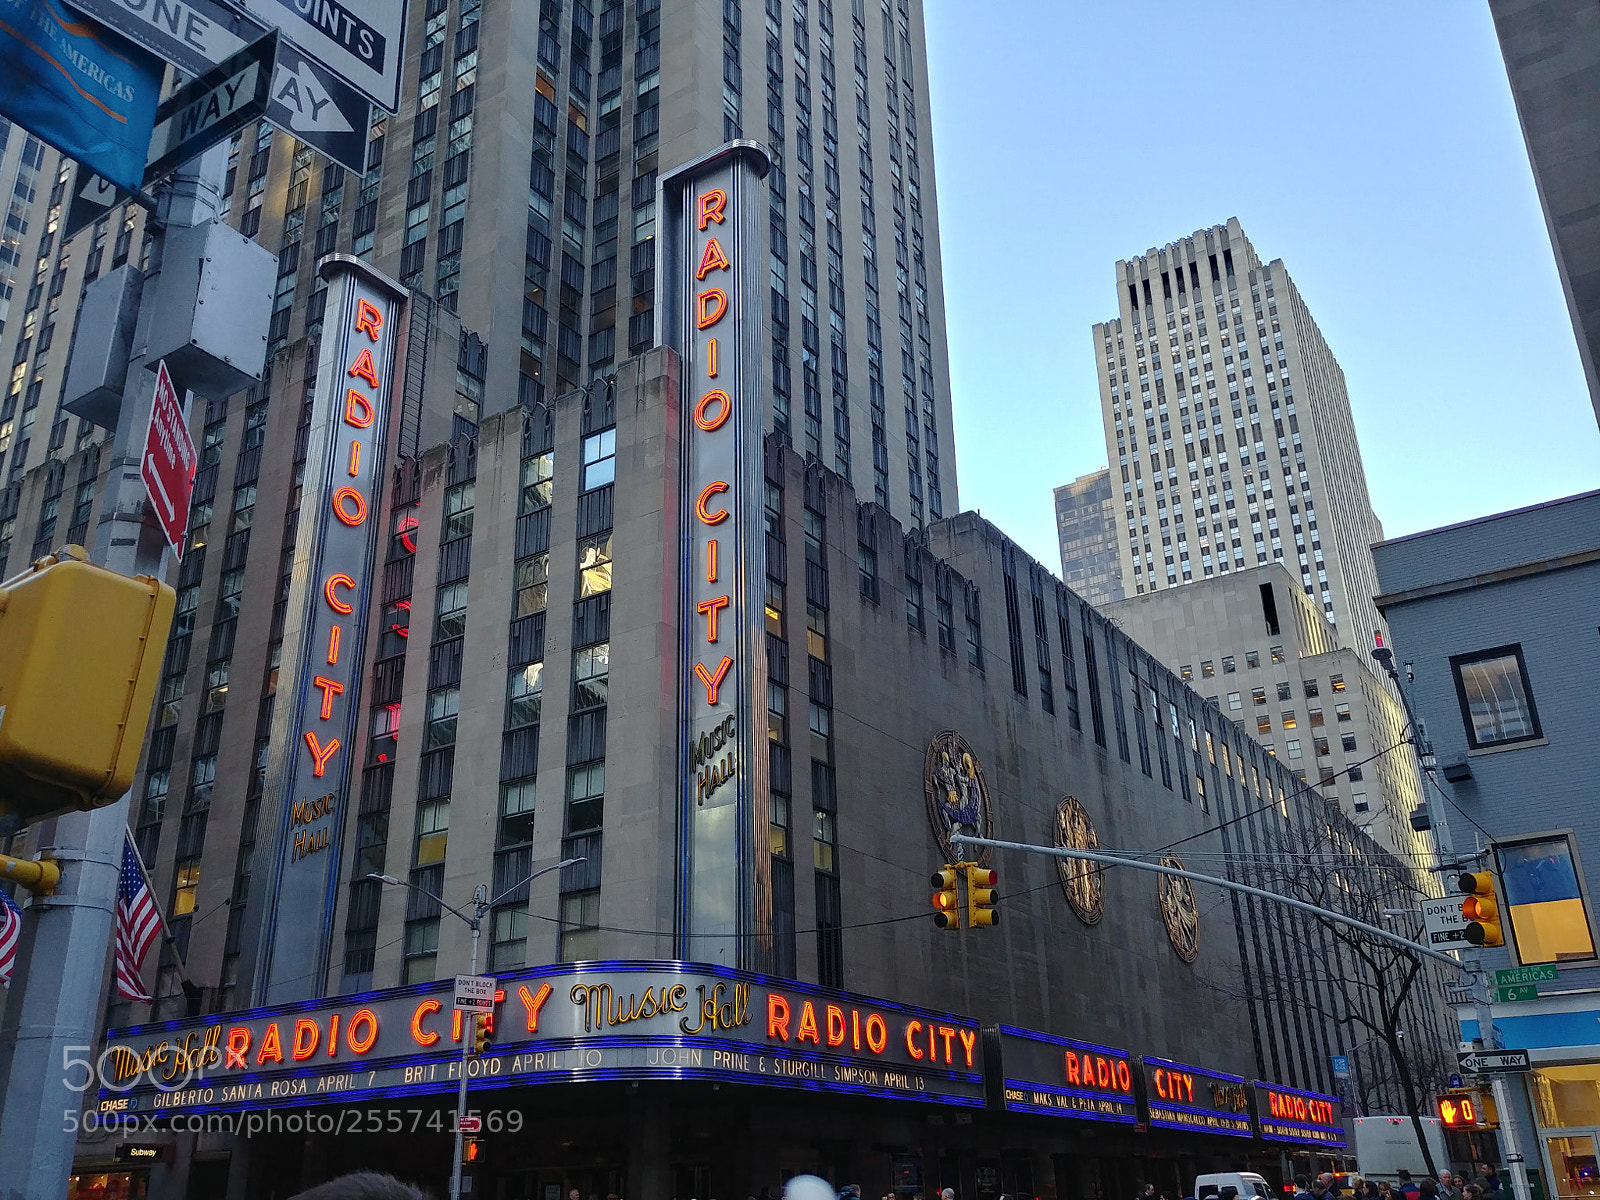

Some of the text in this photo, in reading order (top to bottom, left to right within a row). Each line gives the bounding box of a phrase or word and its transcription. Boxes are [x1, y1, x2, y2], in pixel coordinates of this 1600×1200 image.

[59, 37, 135, 103] AMERICAS
[180, 75, 246, 140] WAY
[276, 75, 330, 122] AY
[694, 188, 731, 432] RADIO
[159, 379, 190, 471] NO STANDING
[333, 298, 383, 526] RADIO
[694, 480, 733, 706] CITY
[304, 573, 356, 777] CITY
[1427, 904, 1454, 915] DON'T
[1440, 915, 1459, 925] THE
[1433, 932, 1450, 942] FINE
[1500, 970, 1554, 985] AMERICAS
[1508, 988, 1517, 1000] 6
[110, 1040, 169, 1082] Music
[162, 1024, 222, 1081] Hall
[225, 1008, 379, 1070] RADIO
[570, 982, 688, 1033] Music
[680, 981, 753, 1034] Hall
[768, 992, 887, 1054] RADIO
[905, 1019, 976, 1067] CITY
[153, 1048, 925, 1108] GILBERTO SANTA ROSA APRIL 7 BRIT FLOYD APRIL 10 JOHN PRINE & STURGILL SIMPSON APRIL 13
[1065, 1050, 1131, 1092] RADIO
[1465, 1056, 1523, 1067] ONE WAY
[1005, 1089, 1024, 1101] CHASE
[1155, 1068, 1194, 1103] CITY
[100, 1099, 129, 1111] CHASE
[1056, 1095, 1069, 1108] VAL
[1072, 1097, 1077, 1109] &
[1079, 1098, 1096, 1111] PETA
[1269, 1091, 1333, 1124] RADIO CITY
[1461, 1100, 1473, 1120] 0
[130, 1147, 157, 1158] Subway
